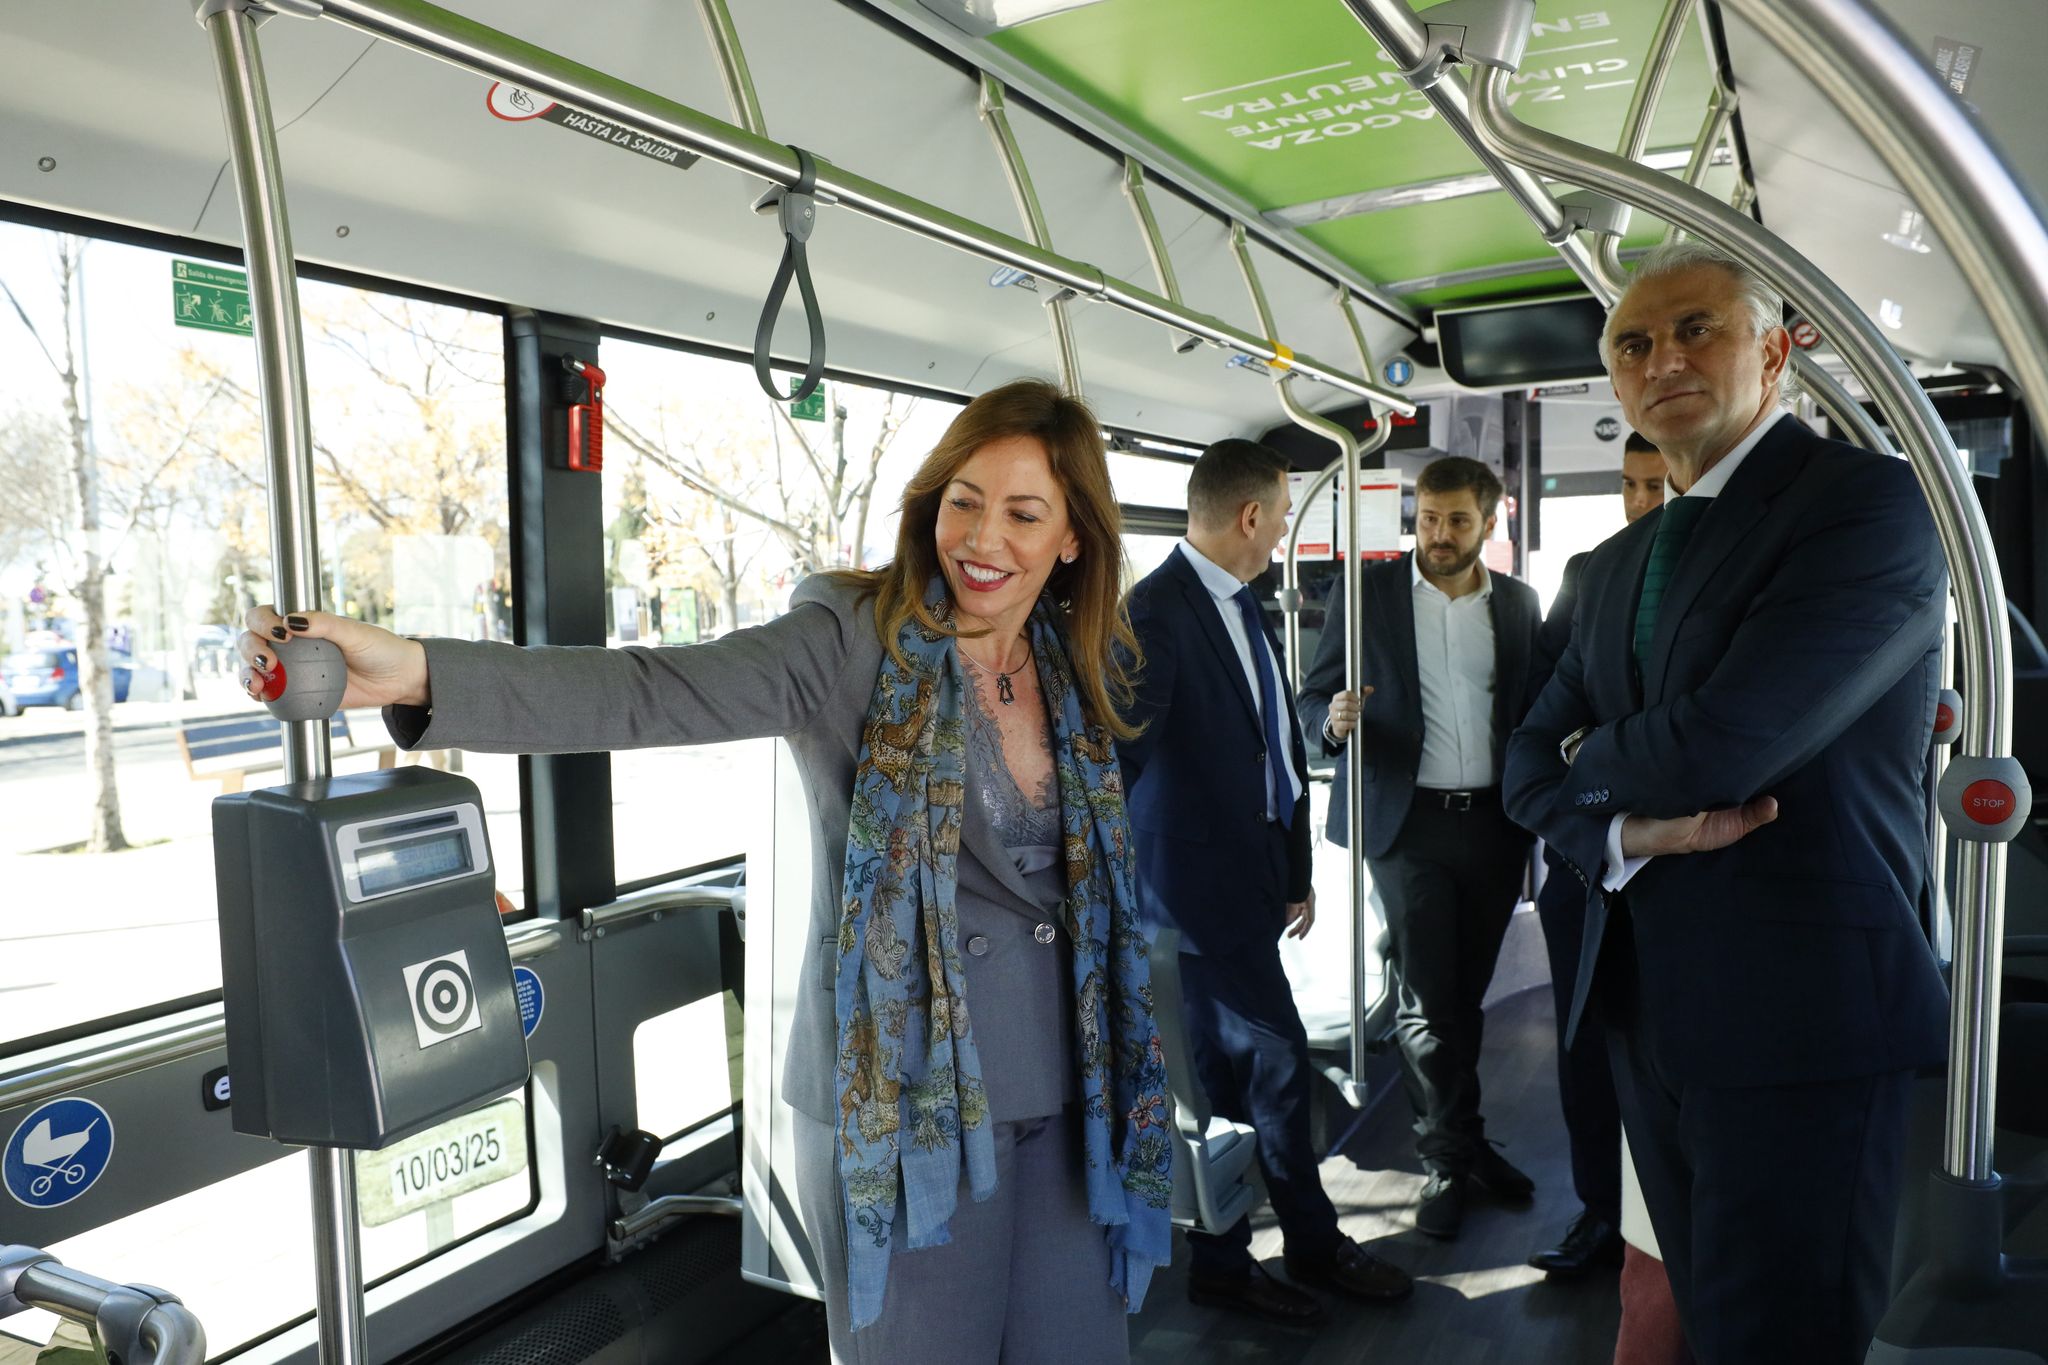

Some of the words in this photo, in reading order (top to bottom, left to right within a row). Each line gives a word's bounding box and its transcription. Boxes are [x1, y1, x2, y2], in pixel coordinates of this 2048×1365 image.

[563, 112, 612, 139] HASTA
[612, 131, 631, 146] LA
[631, 138, 678, 163] SALIDA
[1973, 797, 2005, 808] STOP
[395, 1127, 500, 1196] 10/03/25
